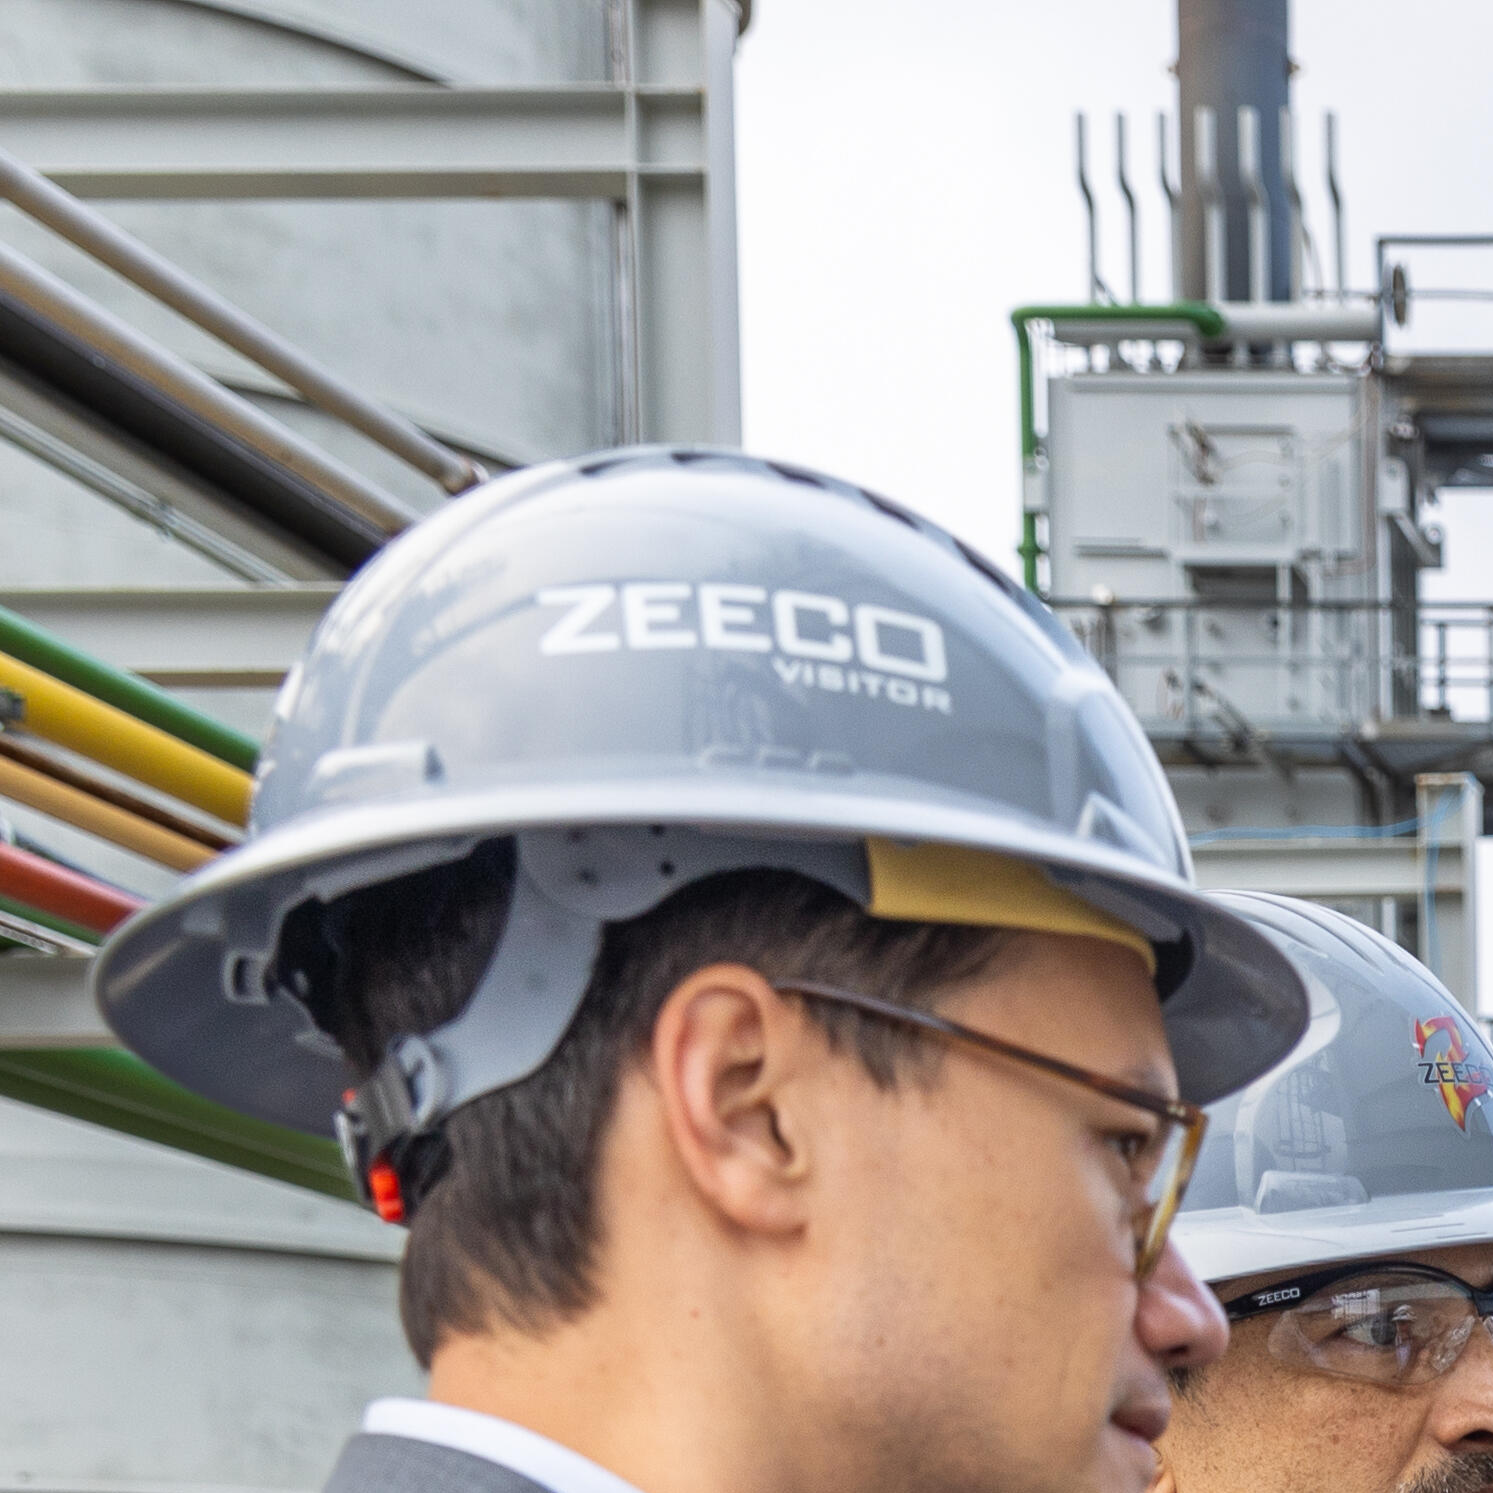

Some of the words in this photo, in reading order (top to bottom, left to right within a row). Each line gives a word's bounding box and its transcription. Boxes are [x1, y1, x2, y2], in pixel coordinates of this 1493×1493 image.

[535, 582, 948, 683] ZEECO
[771, 657, 953, 714] VISITOR
[1258, 1287, 1300, 1306] ZEECO
